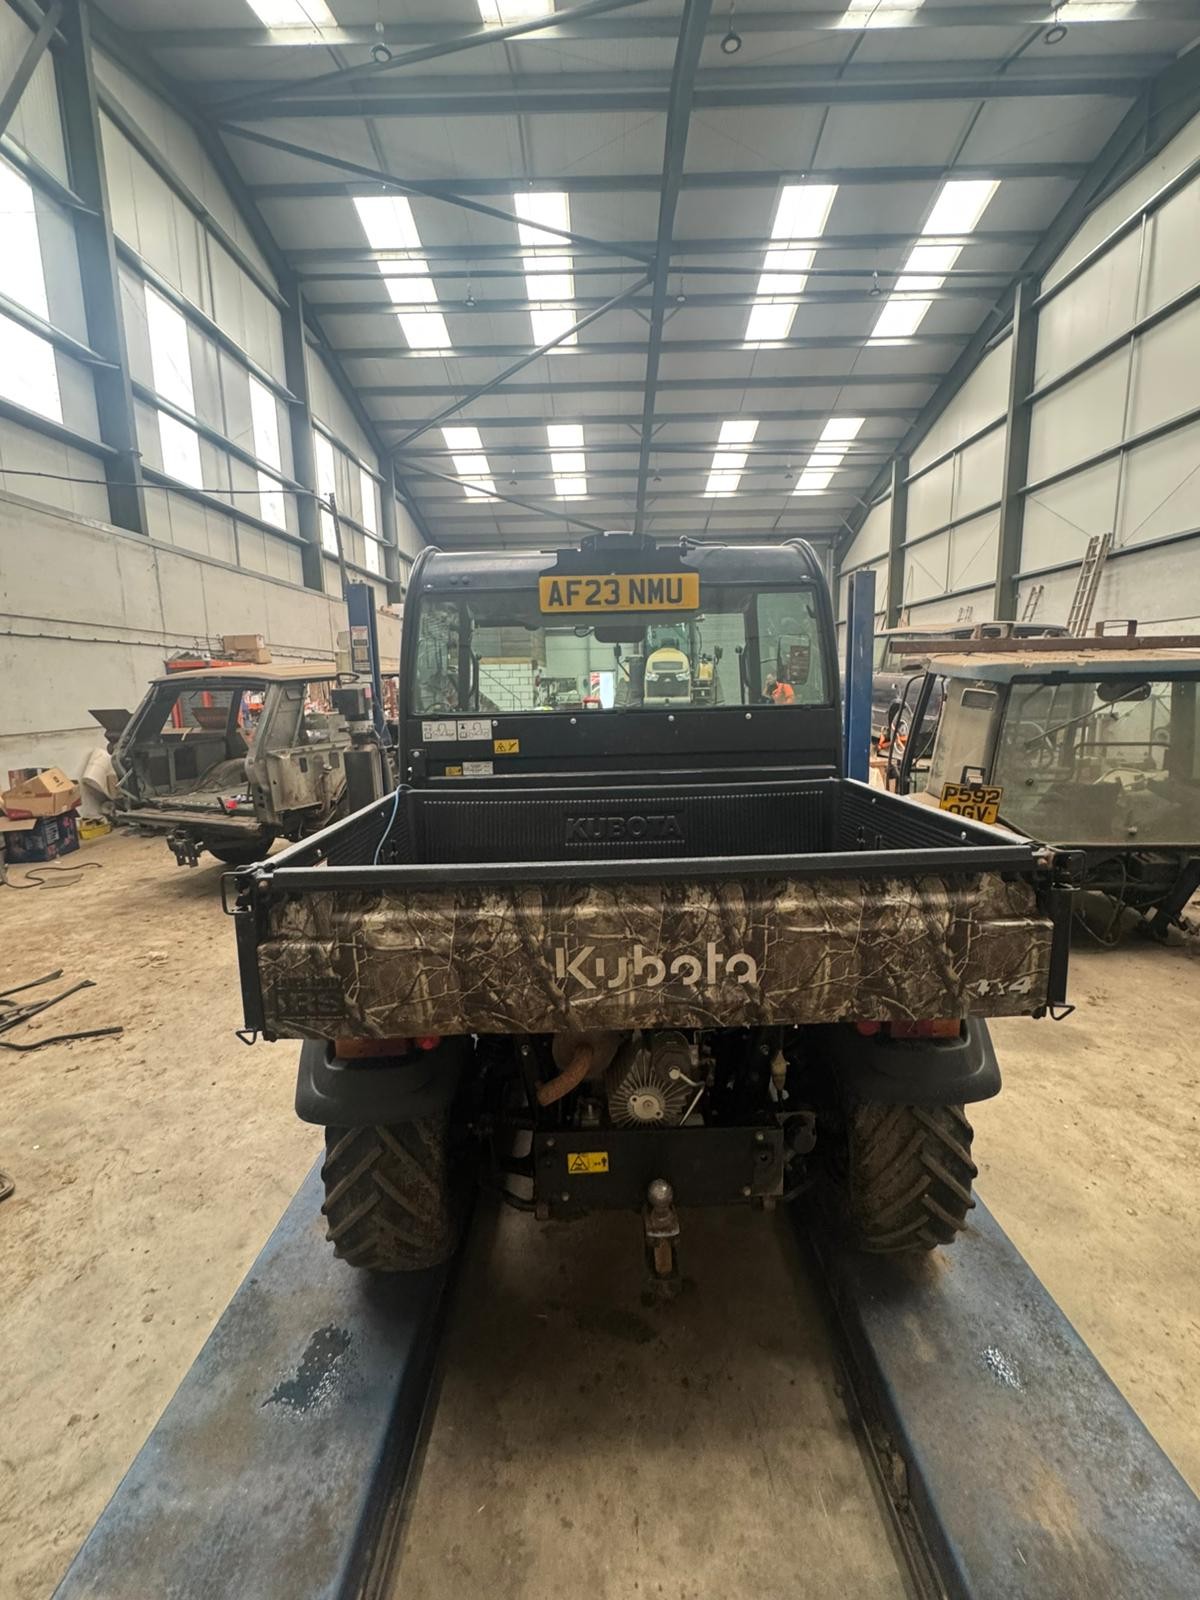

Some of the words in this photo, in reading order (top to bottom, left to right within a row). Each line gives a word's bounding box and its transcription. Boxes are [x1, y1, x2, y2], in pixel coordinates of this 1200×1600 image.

[548, 579, 620, 606] AF23
[629, 578, 683, 605] NMU
[943, 786, 1001, 805] P592
[567, 815, 681, 840] KUBOTA
[555, 942, 758, 989] Kubota
